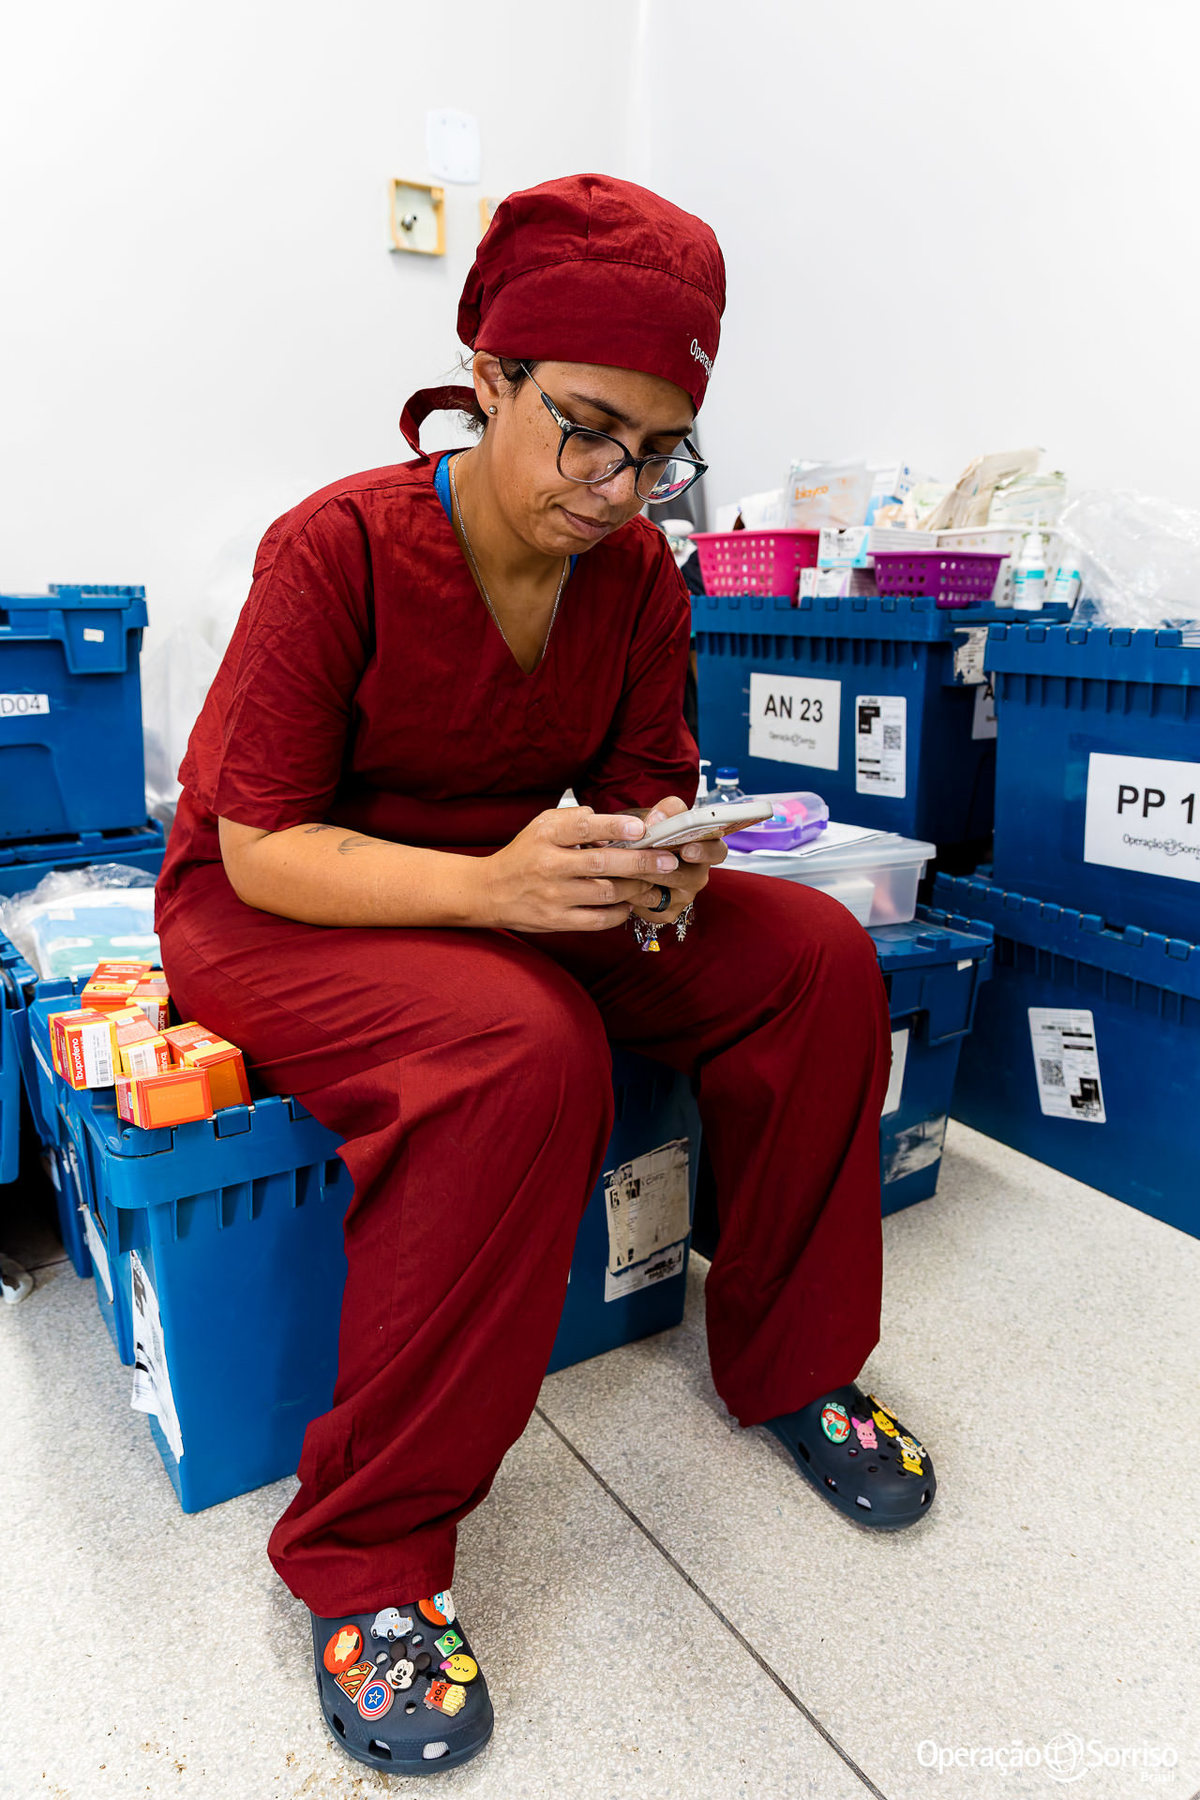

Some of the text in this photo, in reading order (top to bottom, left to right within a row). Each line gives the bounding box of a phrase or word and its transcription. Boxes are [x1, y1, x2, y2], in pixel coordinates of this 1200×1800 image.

[764, 694, 793, 719] AN
[800, 698, 824, 723] 23
[1117, 784, 1195, 824] PP 1
